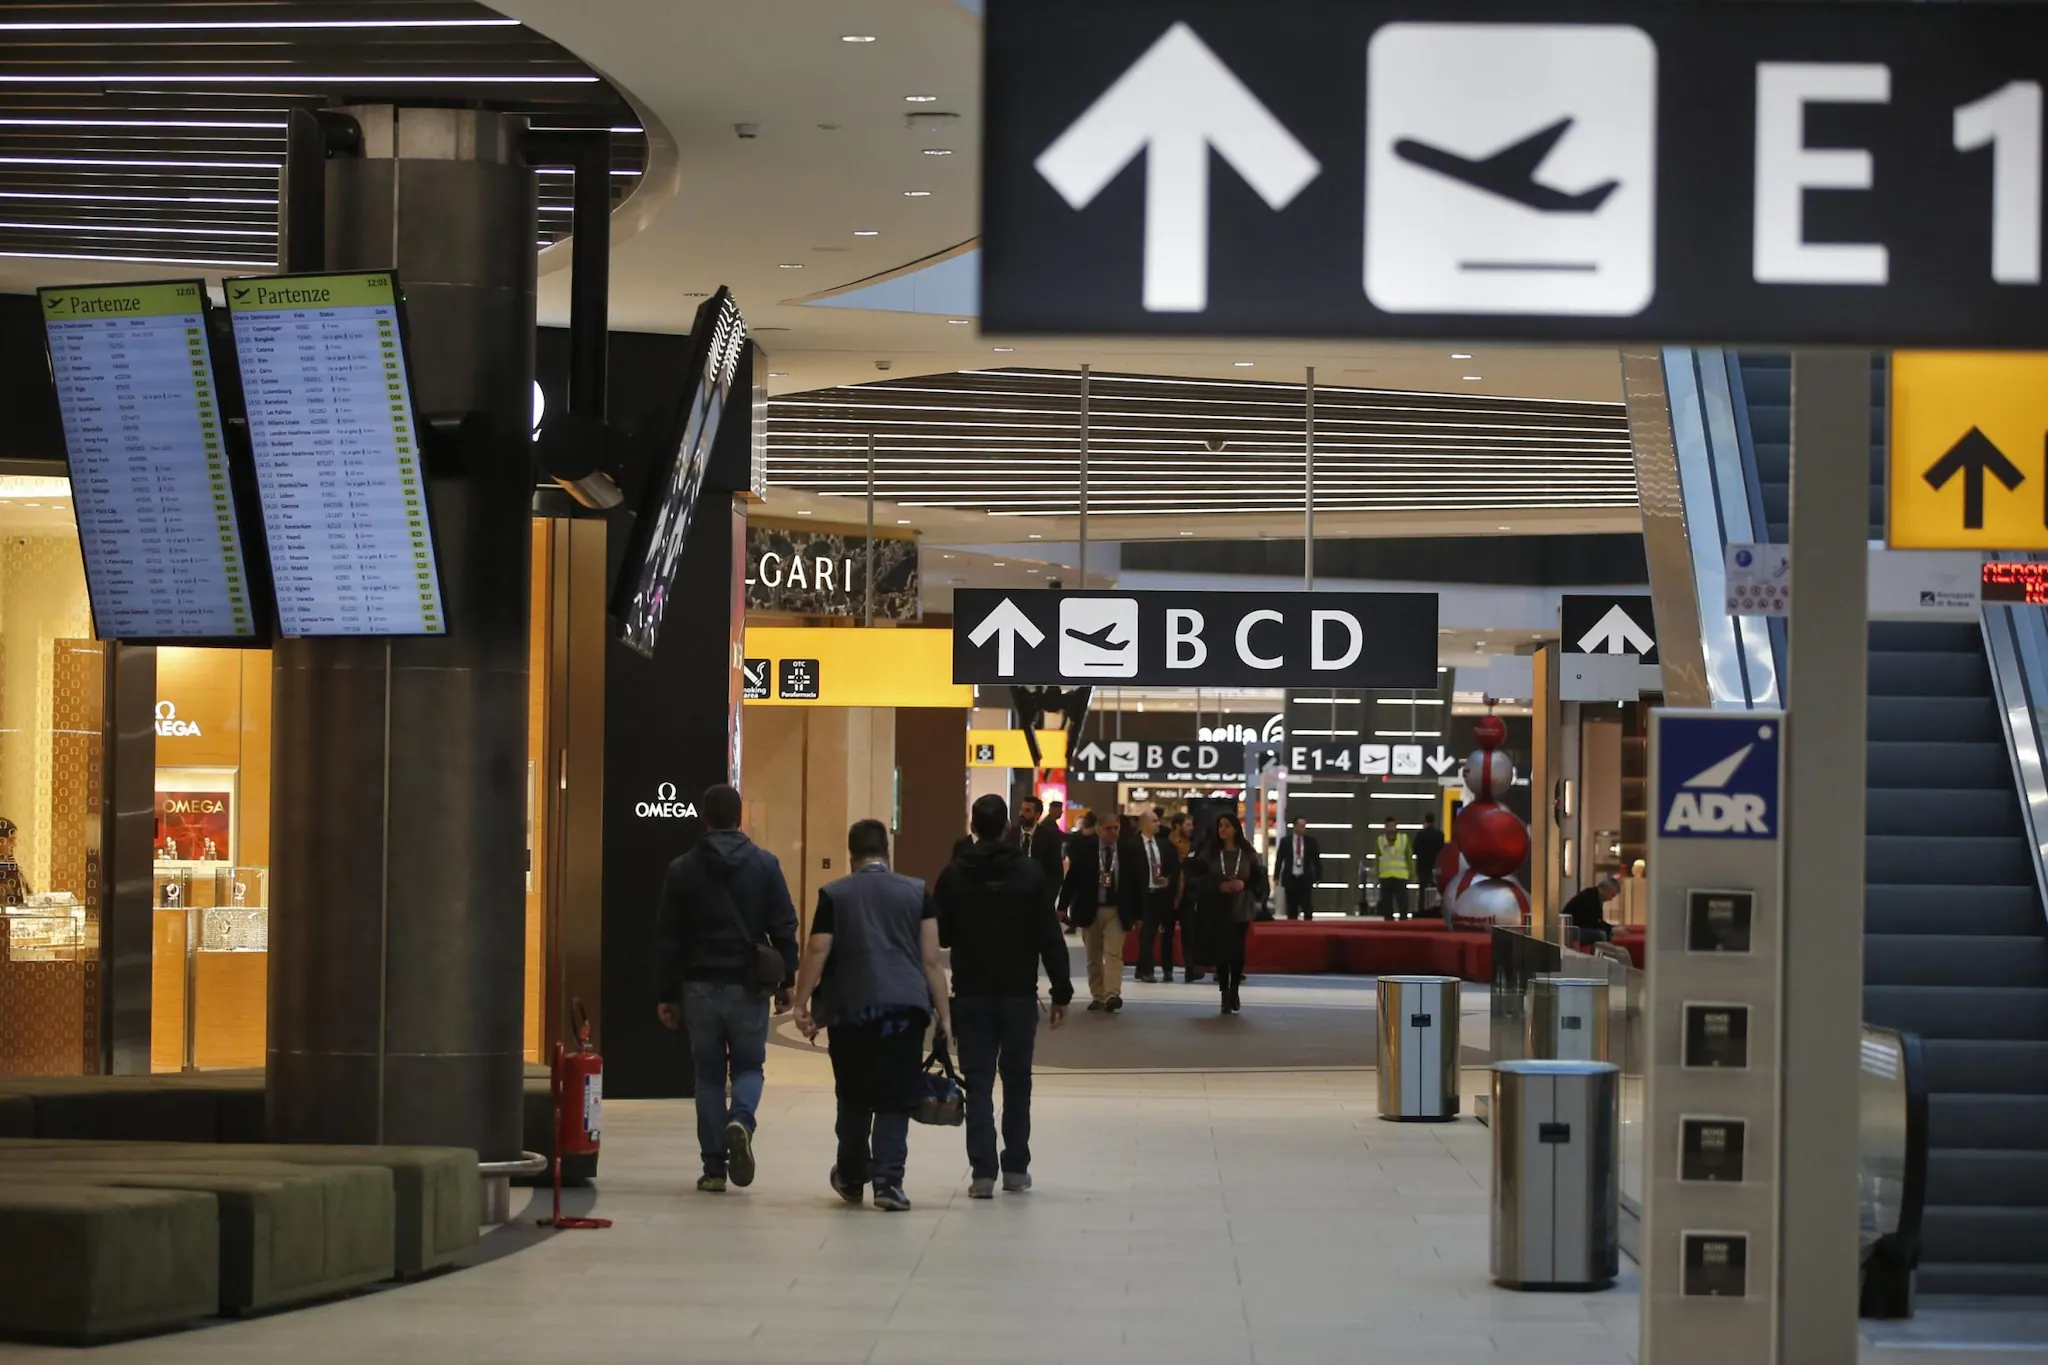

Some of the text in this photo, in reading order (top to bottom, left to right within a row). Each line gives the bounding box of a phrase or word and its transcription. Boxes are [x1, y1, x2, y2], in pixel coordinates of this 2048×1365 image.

[257, 278, 388, 305] Partenze 12:03
[71, 296, 141, 314] Partenze
[1166, 609, 1363, 670] B C D
[1147, 745, 1219, 768] B C D
[164, 799, 225, 813] OMEGA
[635, 802, 698, 818] OMEGA
[1663, 792, 1770, 833] ADR
